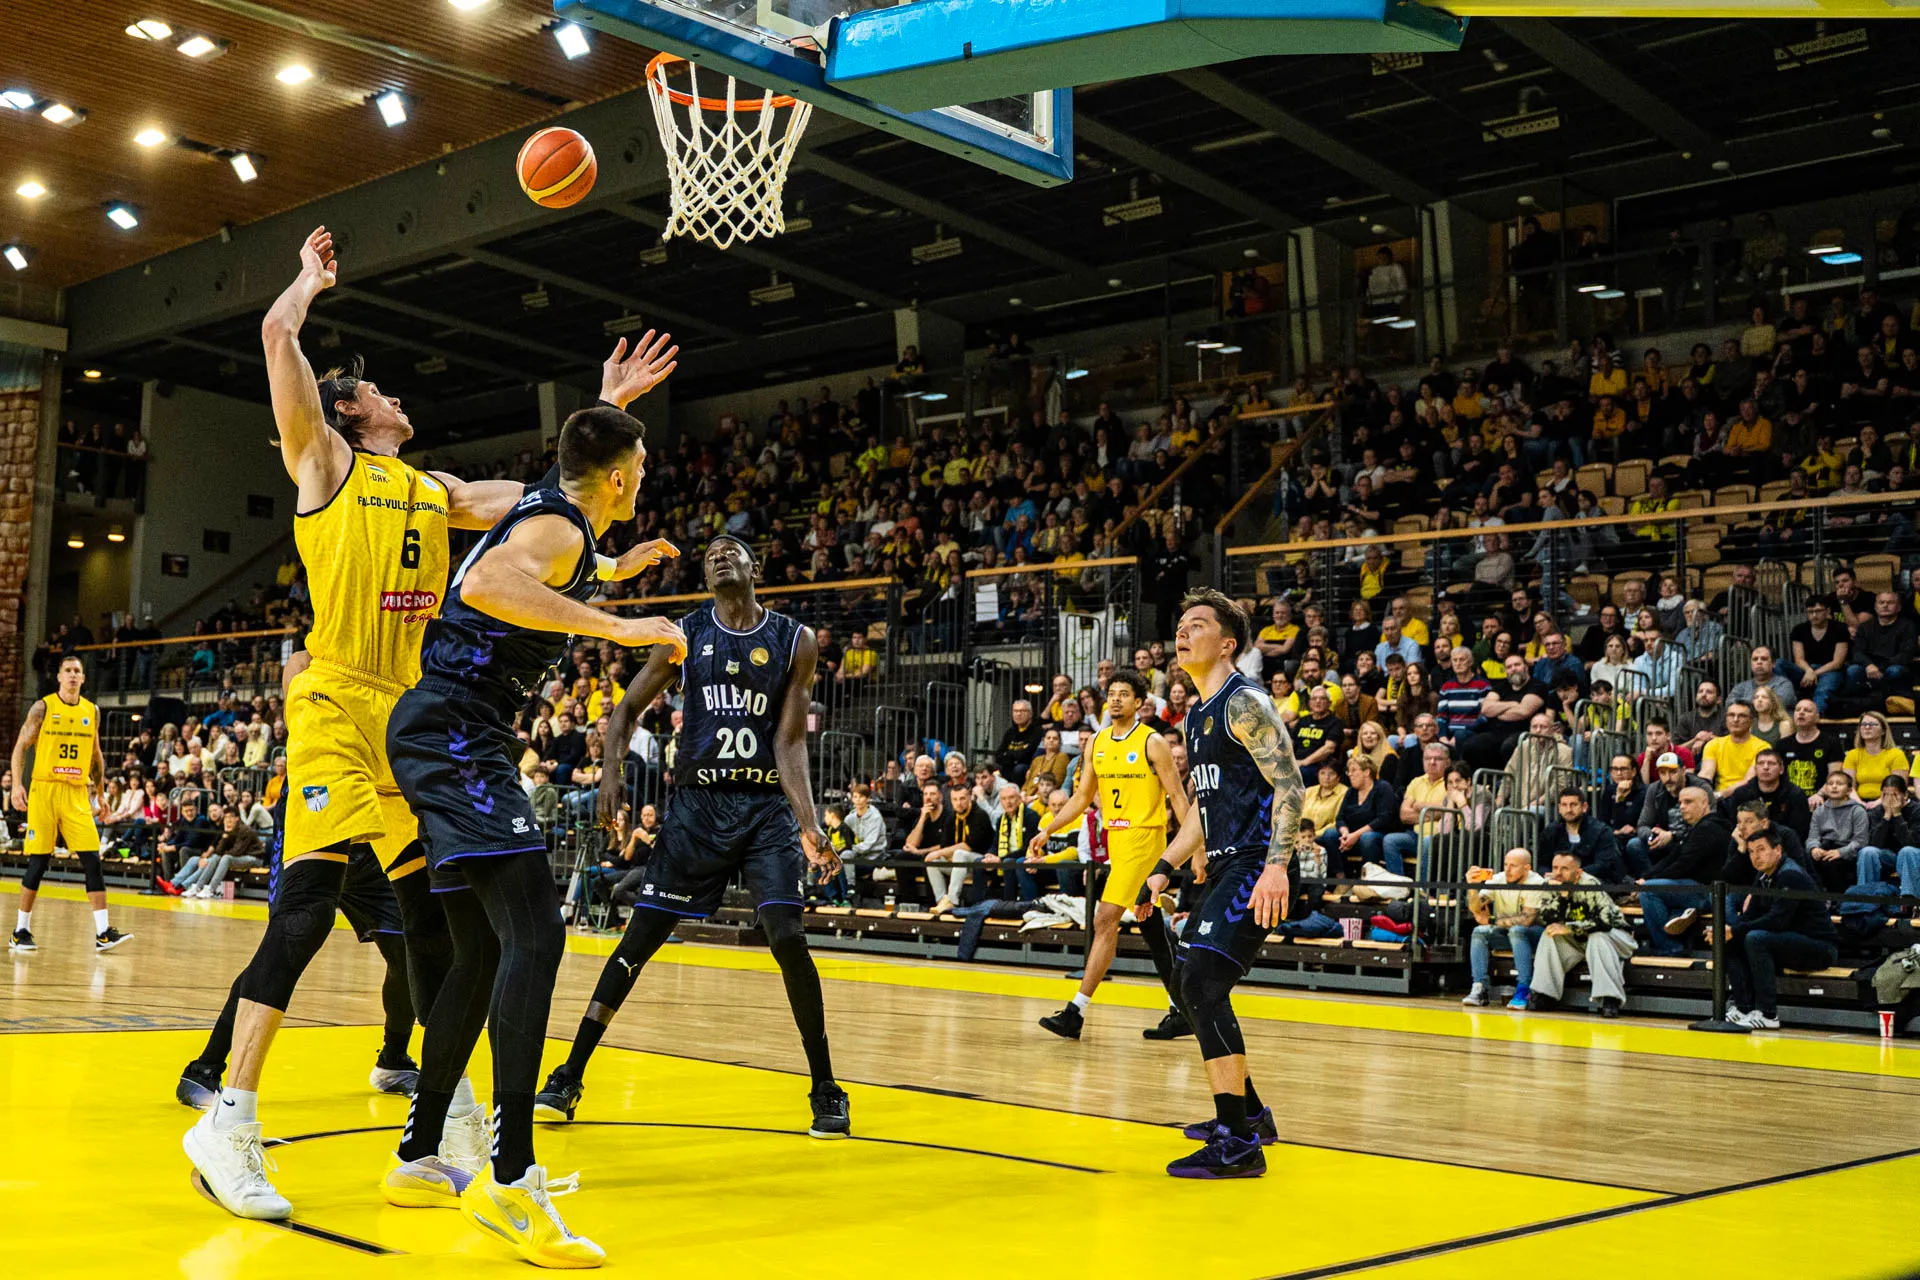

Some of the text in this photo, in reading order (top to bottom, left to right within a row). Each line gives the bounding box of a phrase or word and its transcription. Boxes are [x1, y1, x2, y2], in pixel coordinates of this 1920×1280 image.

[401, 528, 420, 570] 6
[59, 744, 79, 760] 35
[715, 727, 758, 759] 20
[1112, 789, 1122, 809] 2
